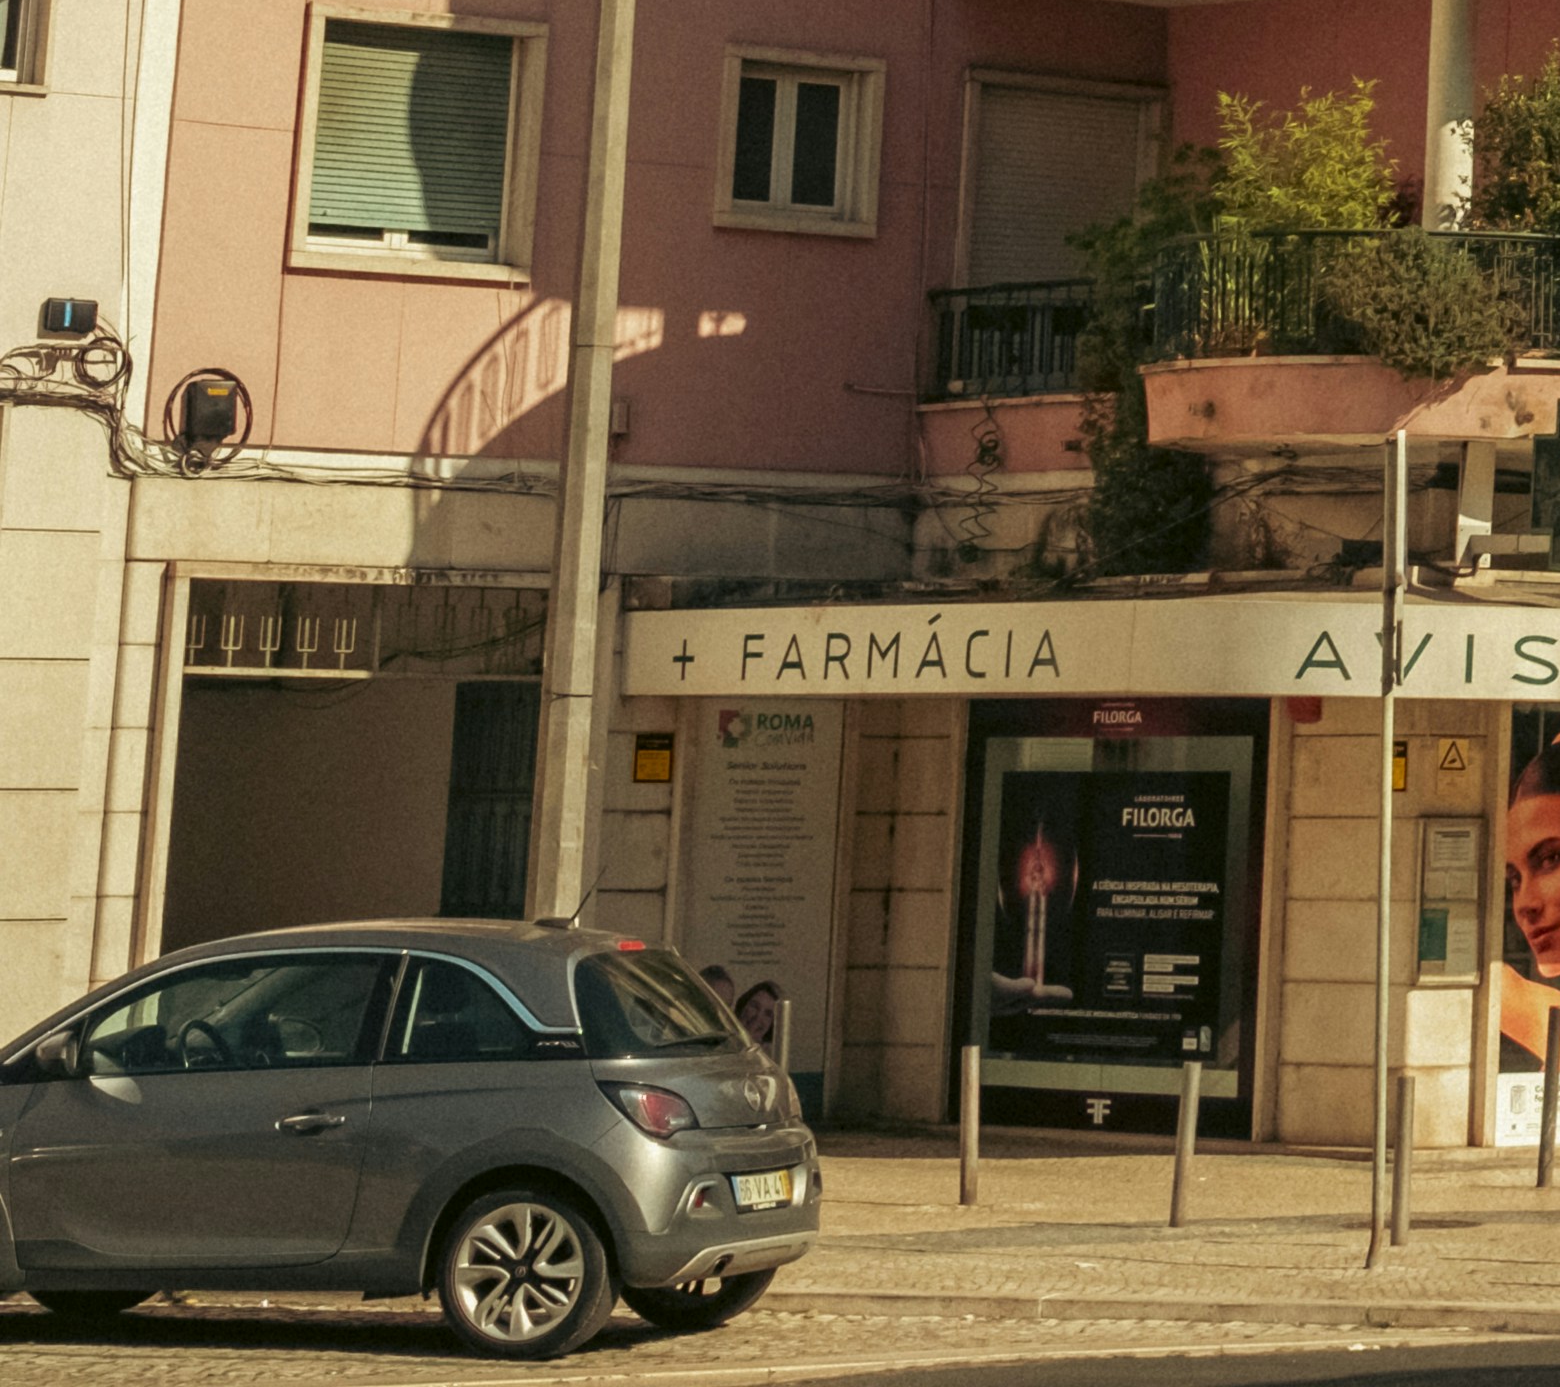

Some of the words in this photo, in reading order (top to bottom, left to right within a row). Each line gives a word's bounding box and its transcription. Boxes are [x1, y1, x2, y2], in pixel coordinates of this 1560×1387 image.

[741, 613, 1060, 680] FARMÁCIA
[1295, 631, 1559, 685] AVIS
[757, 713, 815, 730] ROMA
[1093, 710, 1142, 724] FILORGA
[1122, 807, 1195, 827] FILORGA
